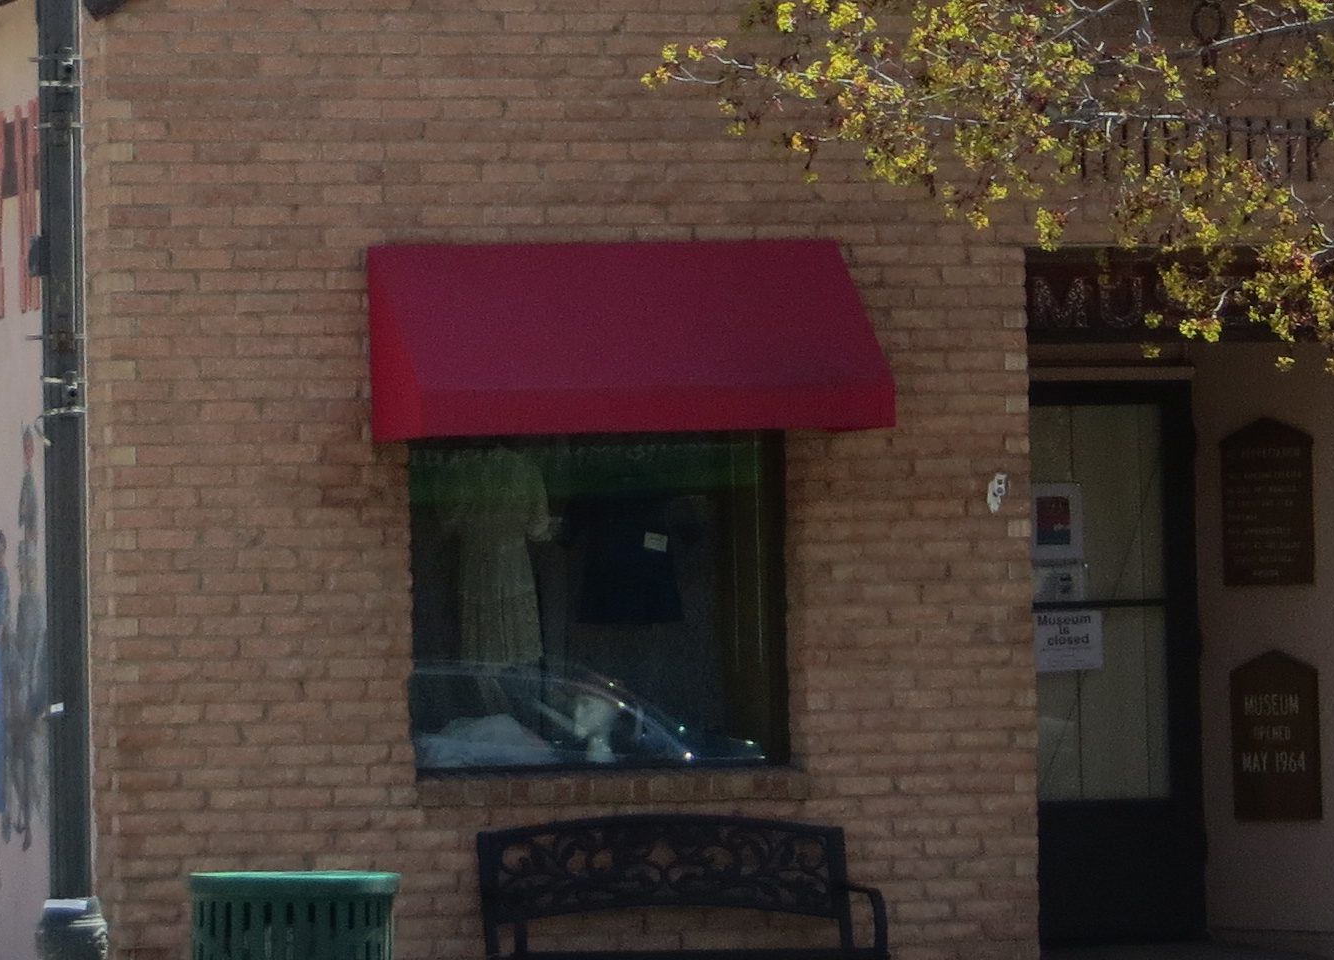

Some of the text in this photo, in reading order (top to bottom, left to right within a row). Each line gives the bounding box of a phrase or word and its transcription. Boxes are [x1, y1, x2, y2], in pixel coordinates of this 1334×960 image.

[1037, 615, 1091, 626] Museum
[1047, 634, 1089, 646] closed
[1244, 693, 1299, 716] MUSEUM
[1242, 749, 1306, 773] MAY 1964
